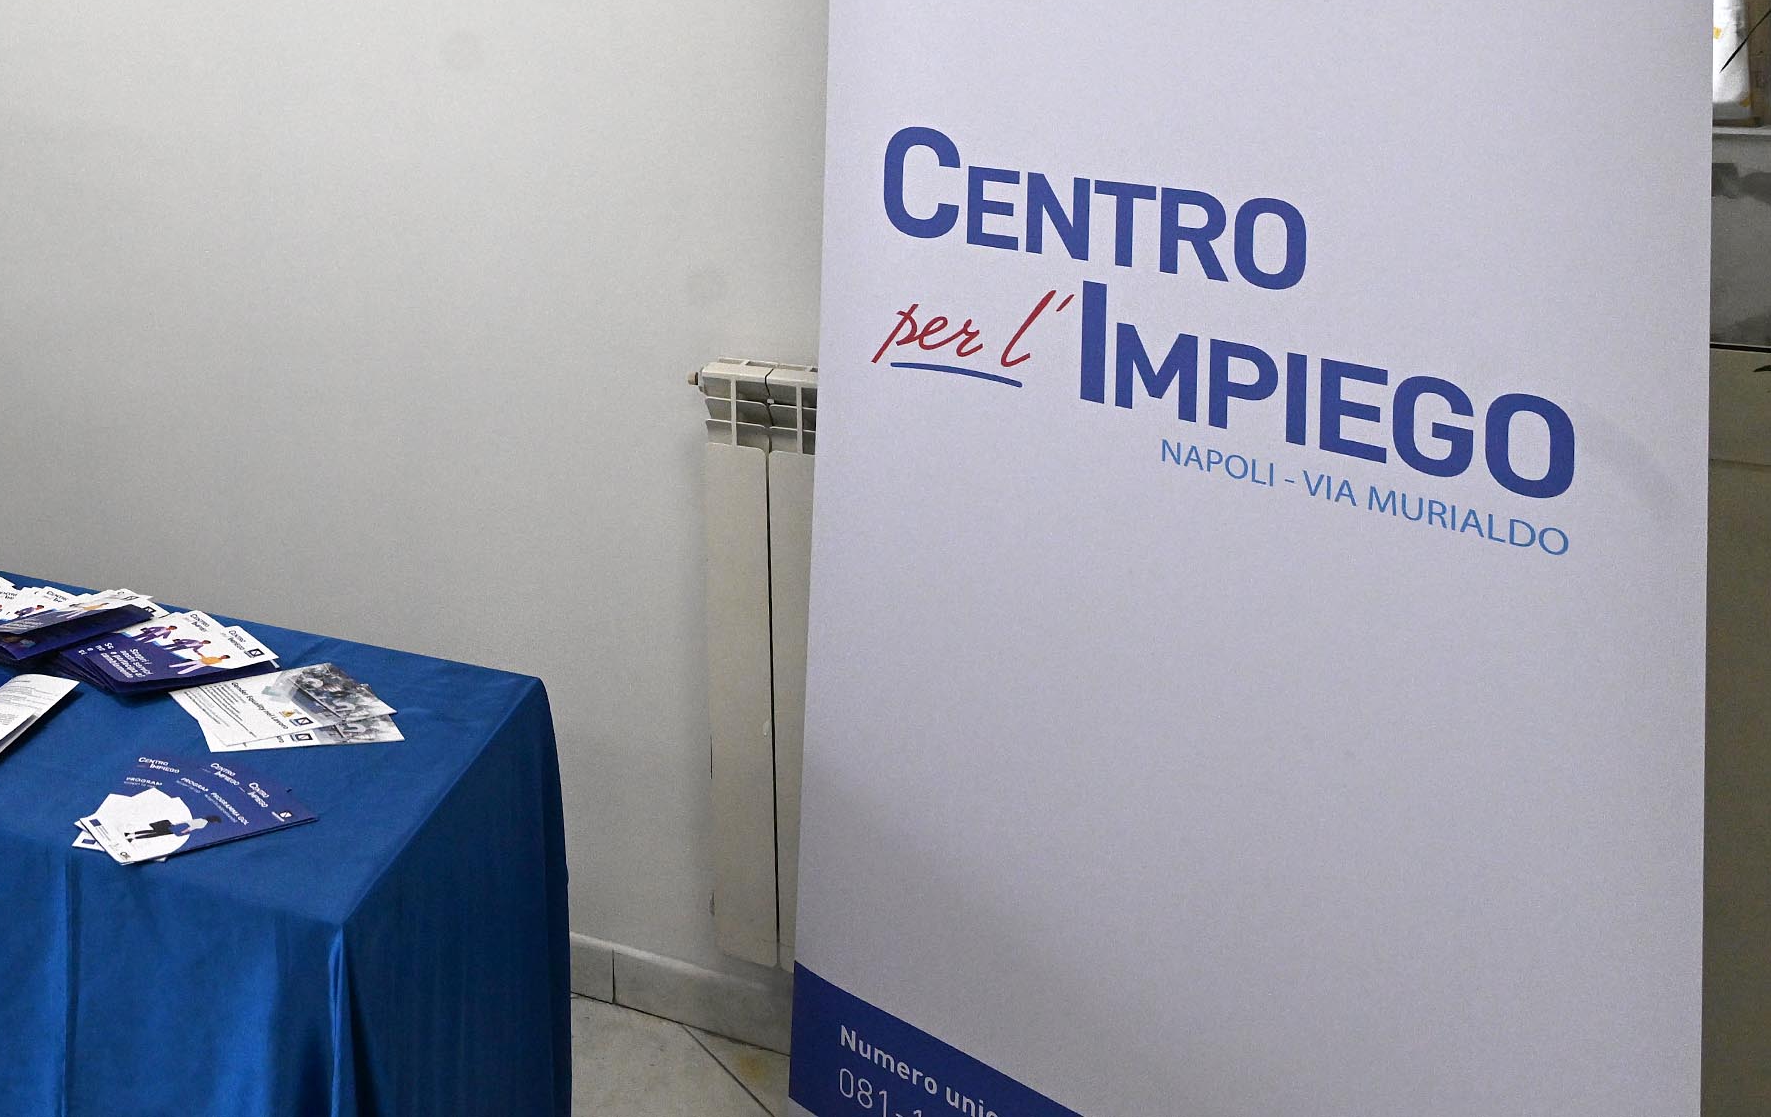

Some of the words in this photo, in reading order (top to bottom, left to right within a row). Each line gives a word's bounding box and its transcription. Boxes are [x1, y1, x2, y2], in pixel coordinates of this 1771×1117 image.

[884, 127, 1306, 290] CENTRO
[871, 304, 983, 364] per
[1001, 290, 1074, 367] l'
[1080, 281, 1575, 506] IMPIEGO
[1162, 439, 1274, 487] NAPOLI
[1303, 470, 1357, 506] VIA
[1369, 486, 1568, 555] MURIALDO
[840, 1025, 937, 1095] Numero
